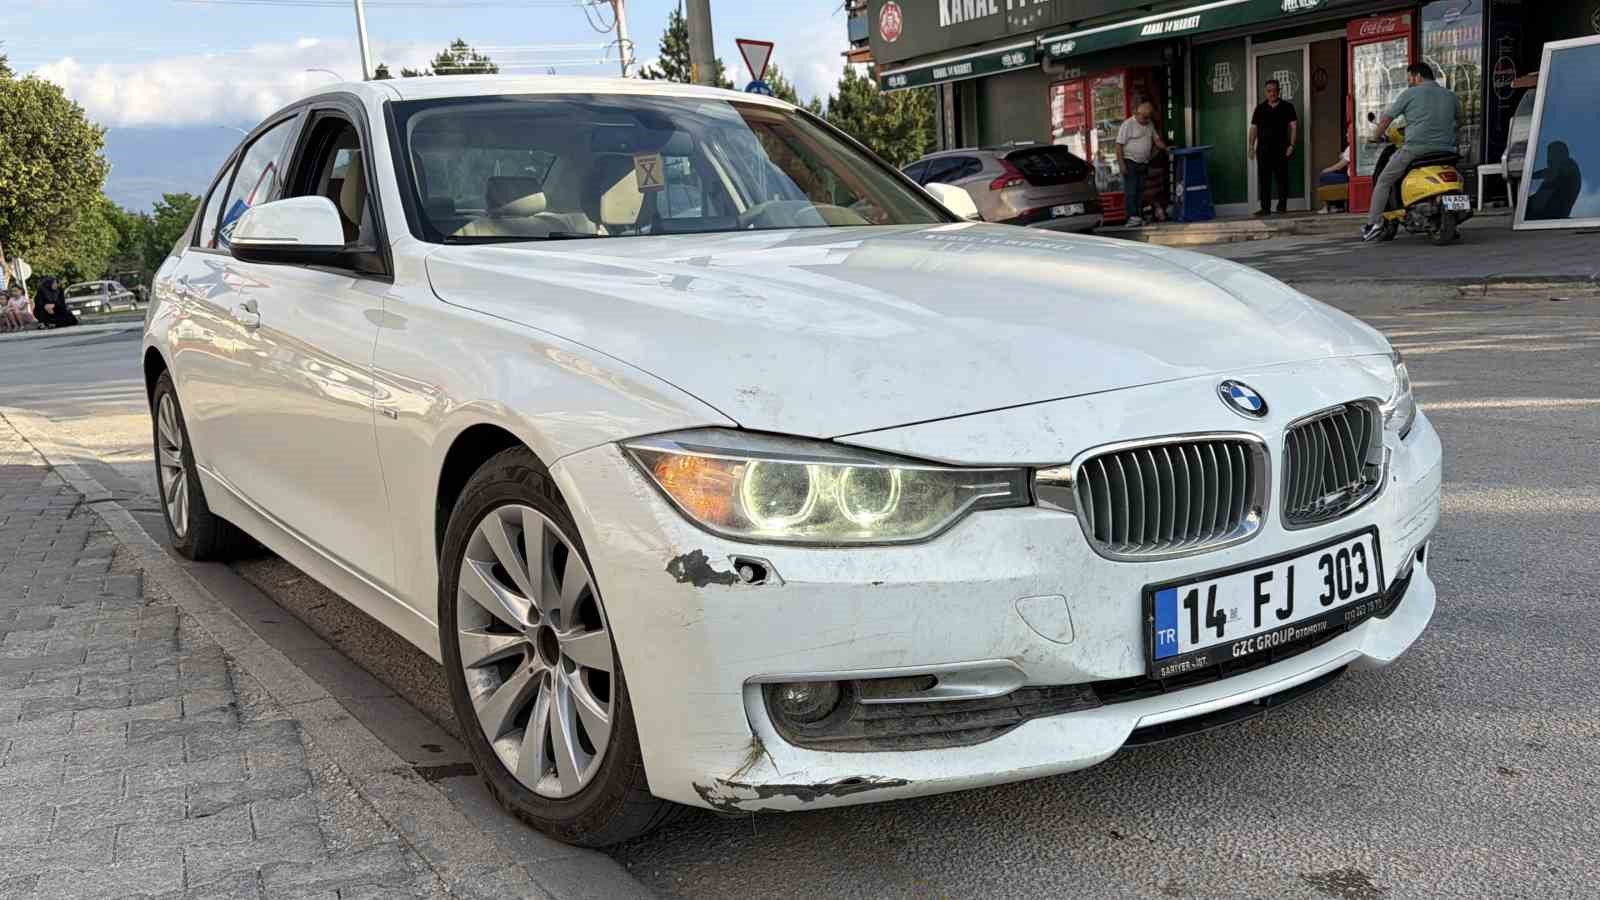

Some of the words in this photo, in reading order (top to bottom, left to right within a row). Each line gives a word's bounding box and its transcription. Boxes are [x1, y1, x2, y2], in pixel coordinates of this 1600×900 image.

[1158, 628, 1175, 645] TR
[1183, 584, 1227, 645] 14
[1253, 565, 1295, 628] FJ
[1318, 542, 1369, 607] 303
[1232, 638, 1254, 658] GZC
[1256, 627, 1295, 651] GROUP
